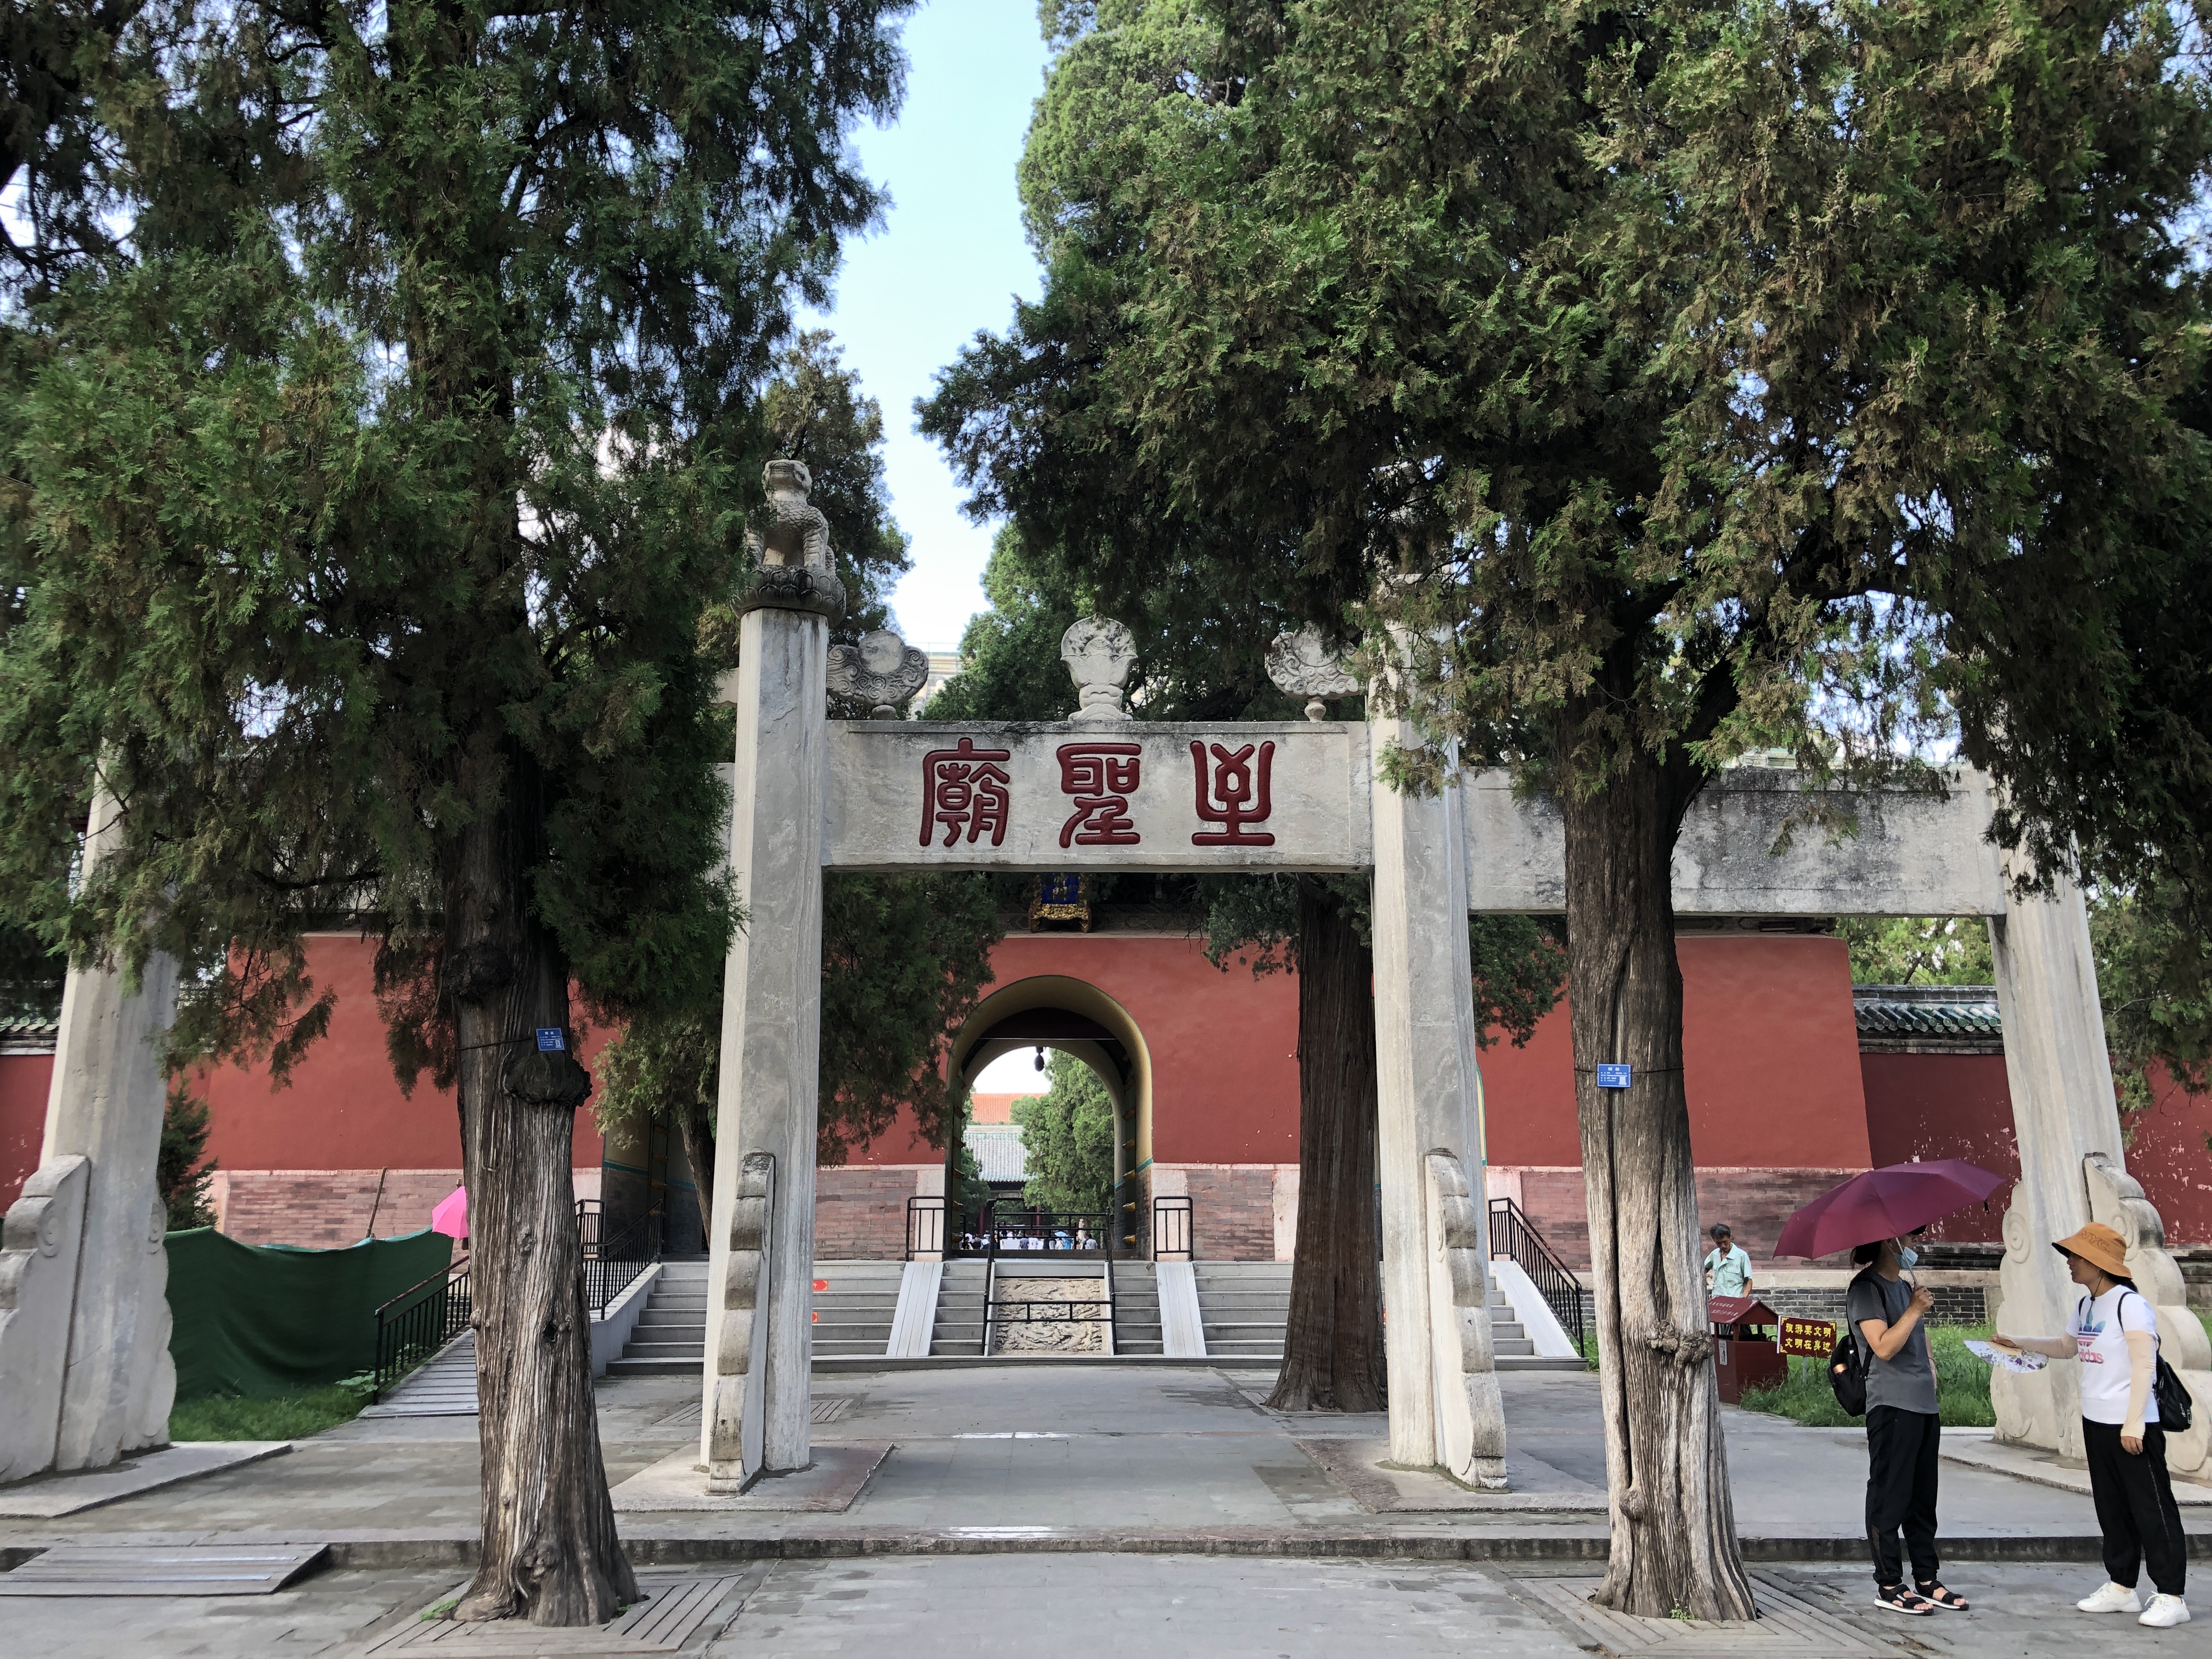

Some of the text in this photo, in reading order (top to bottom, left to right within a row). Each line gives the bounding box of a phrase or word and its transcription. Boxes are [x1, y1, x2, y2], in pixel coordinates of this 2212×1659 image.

[1785, 1323, 1831, 1338] 旅游要文明
[1785, 1338, 1831, 1352] 文明在身边
